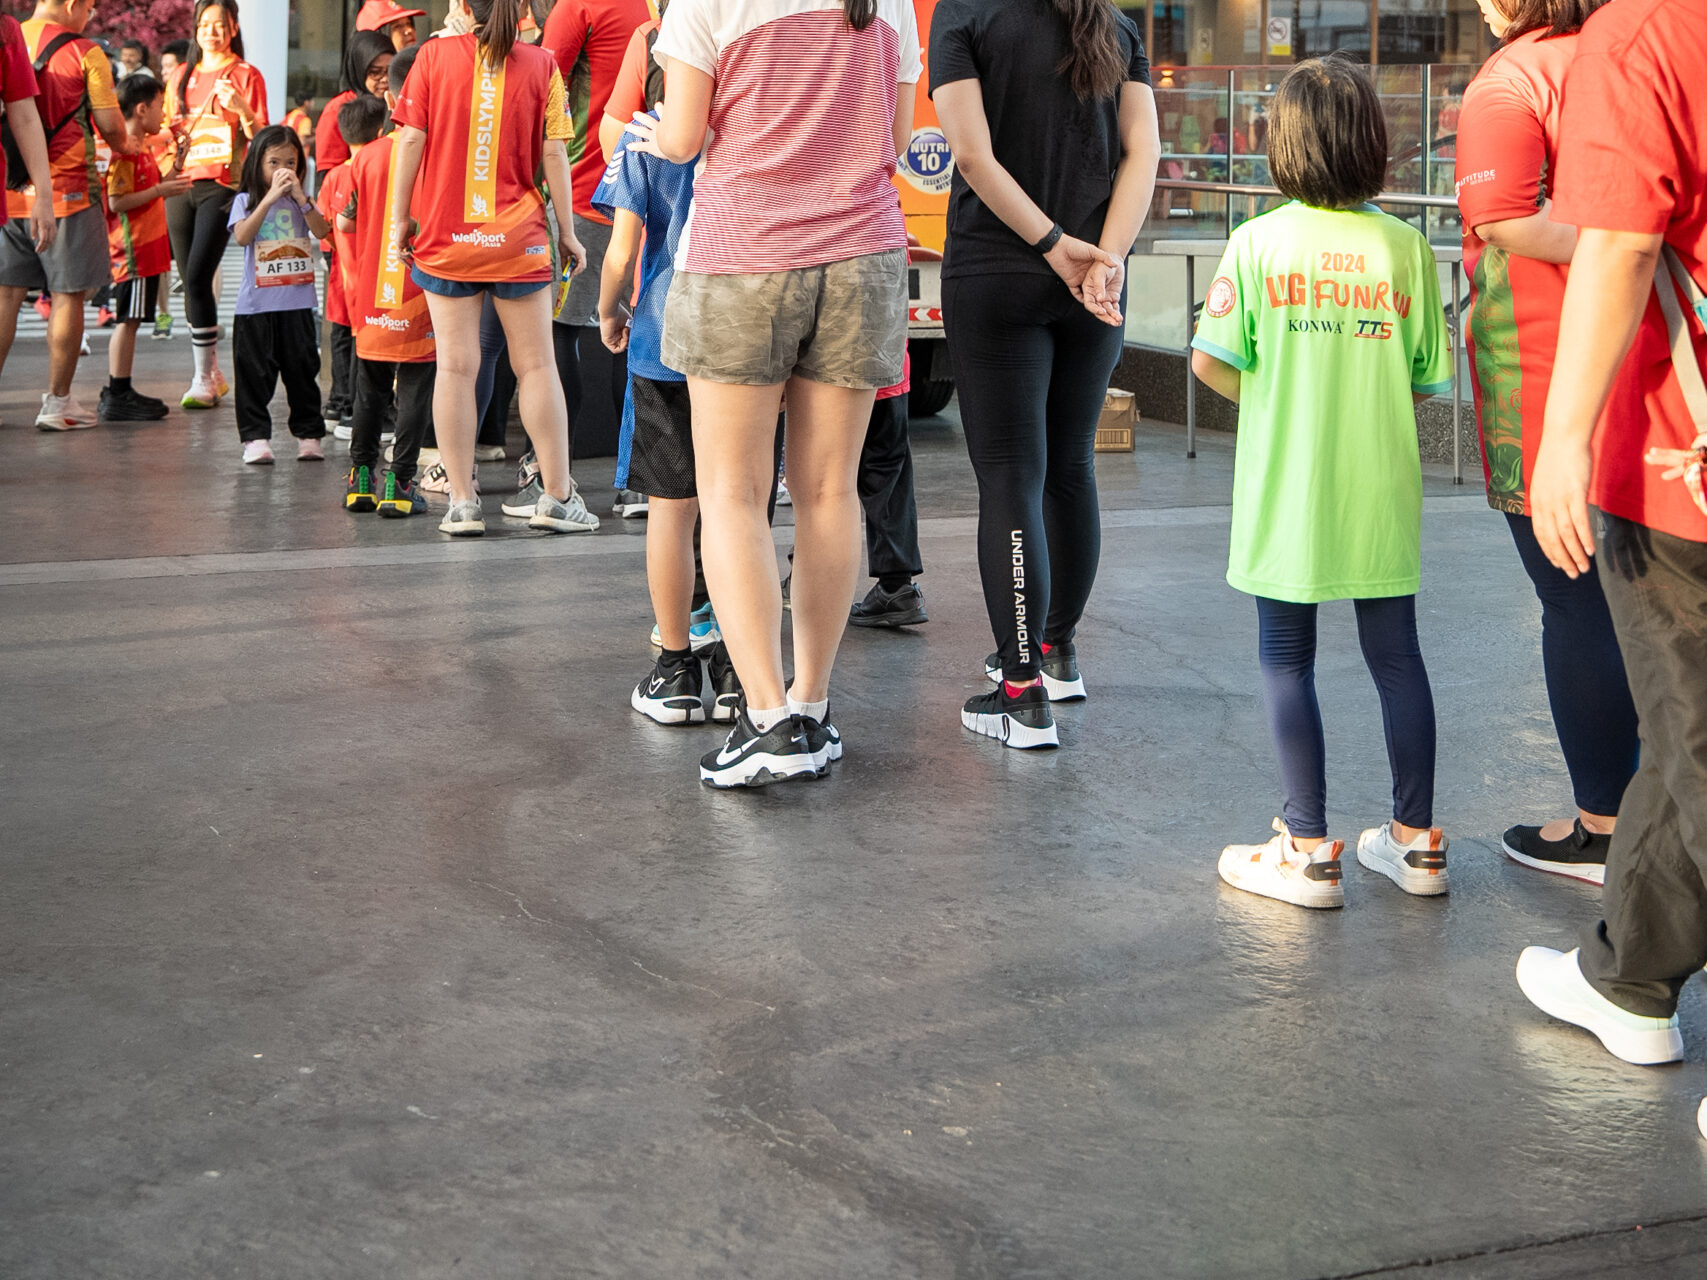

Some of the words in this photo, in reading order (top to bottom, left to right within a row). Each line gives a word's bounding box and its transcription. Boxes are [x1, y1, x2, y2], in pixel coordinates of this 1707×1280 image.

[910, 142, 950, 153] NUTRI
[917, 152, 941, 172] 10
[267, 262, 284, 274] AF
[287, 260, 306, 272] 133
[1321, 252, 1366, 273] 2024
[1354, 320, 1393, 339] TTS
[1010, 529, 1025, 589] UNDER
[1014, 591, 1030, 664] ARMOUR
